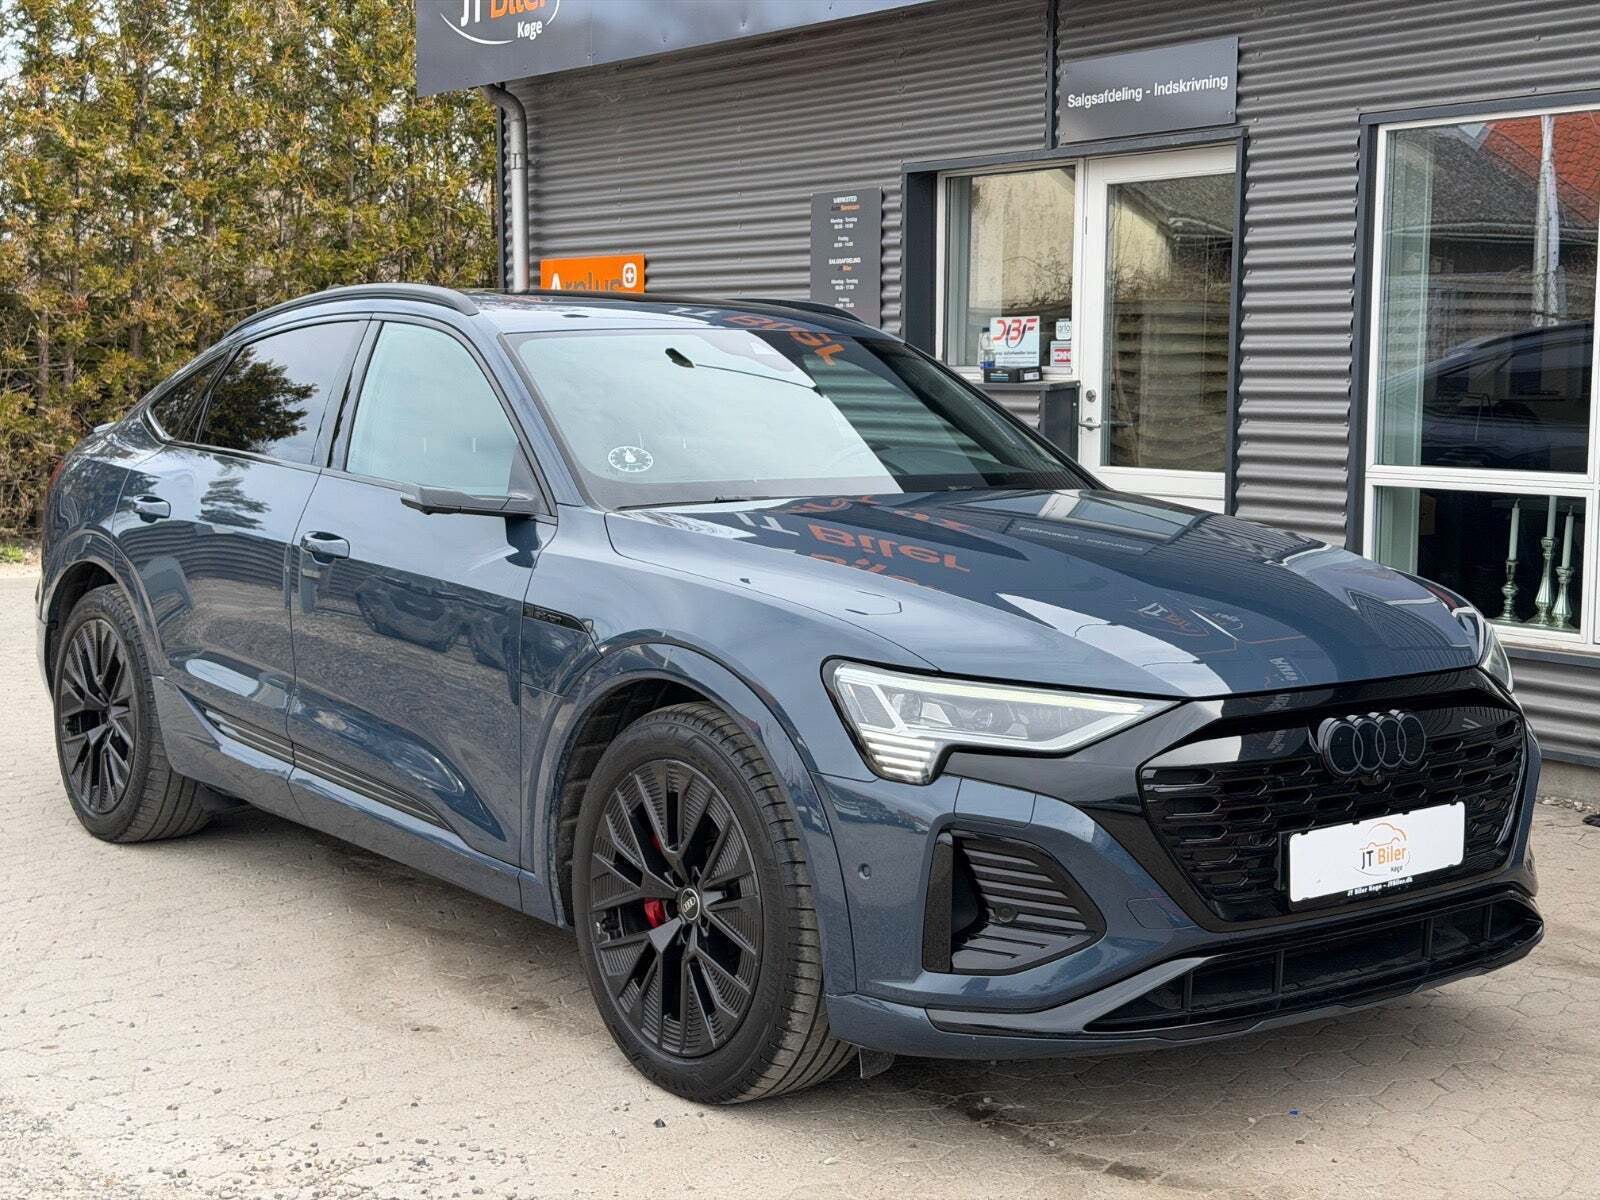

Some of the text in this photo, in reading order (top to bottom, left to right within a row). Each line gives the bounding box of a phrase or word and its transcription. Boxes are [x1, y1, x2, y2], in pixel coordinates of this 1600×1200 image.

[517, 21, 543, 40] Køge
[1067, 86, 1143, 109] Salgsafdeling
[1154, 74, 1228, 97] Indskrivning
[1361, 846, 1406, 870] JT Biler
